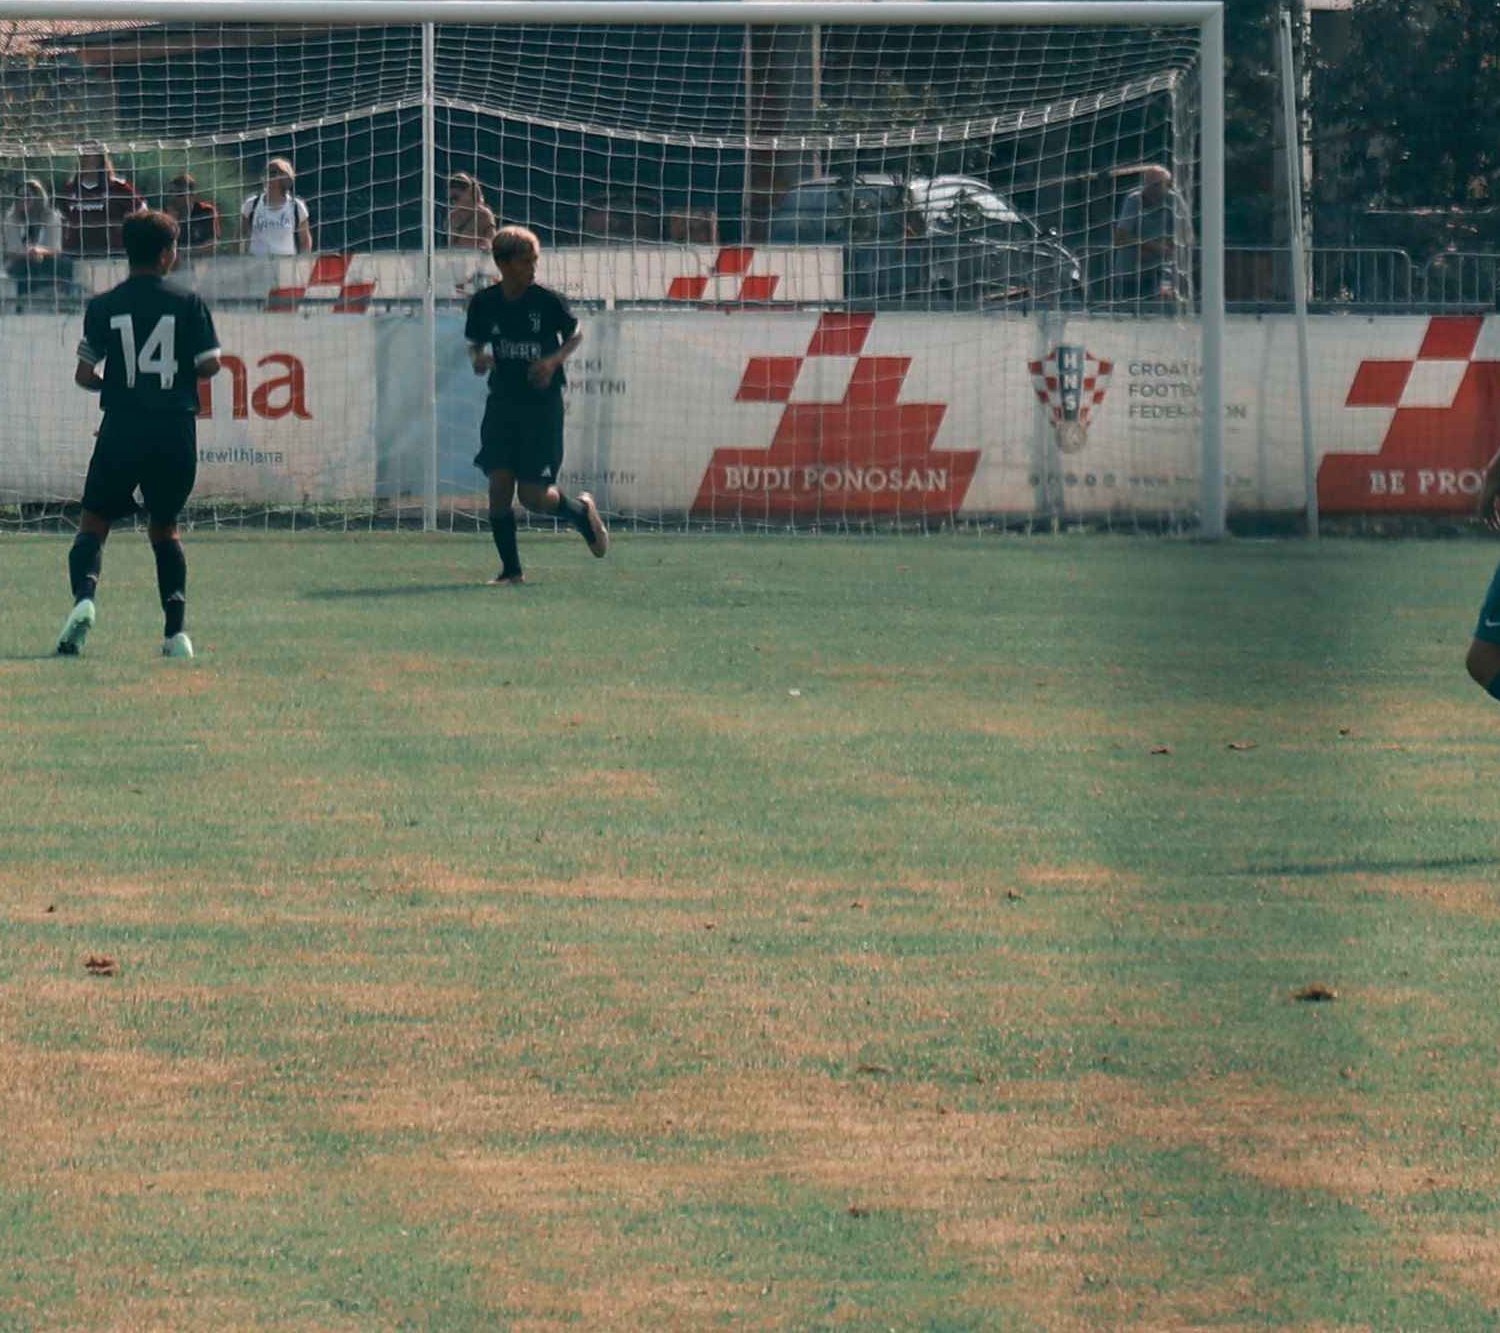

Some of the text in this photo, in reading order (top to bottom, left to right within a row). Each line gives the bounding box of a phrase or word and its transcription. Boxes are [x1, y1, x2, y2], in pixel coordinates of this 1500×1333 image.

[110, 312, 178, 389] 14
[725, 466, 949, 493] BUDI PONOSAN
[1369, 469, 1406, 495] BE
